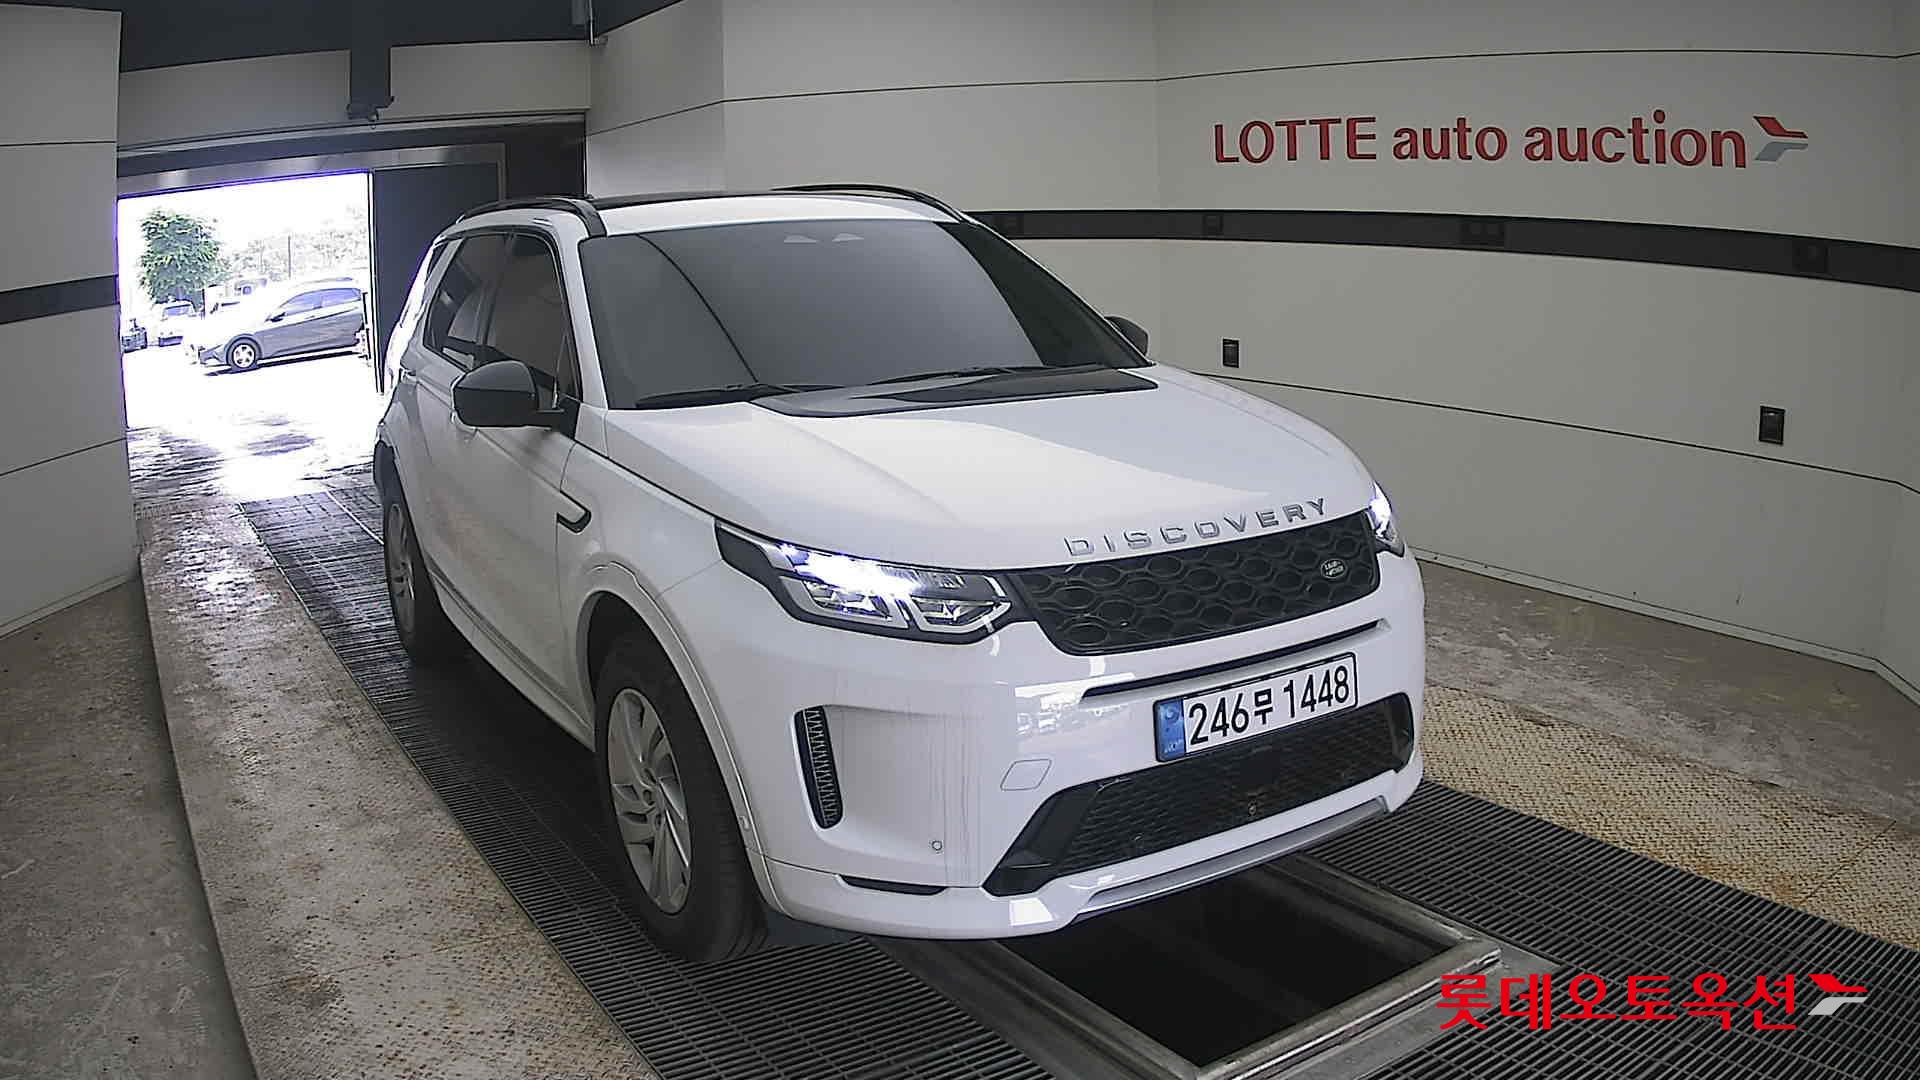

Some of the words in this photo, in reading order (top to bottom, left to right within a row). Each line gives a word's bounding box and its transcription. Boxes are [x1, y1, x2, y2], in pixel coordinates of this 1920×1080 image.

[1214, 117, 1377, 163] LOTTE
[1392, 117, 1507, 161] auto
[1524, 110, 1746, 168] auction
[1064, 497, 1326, 557] DISCOVERY
